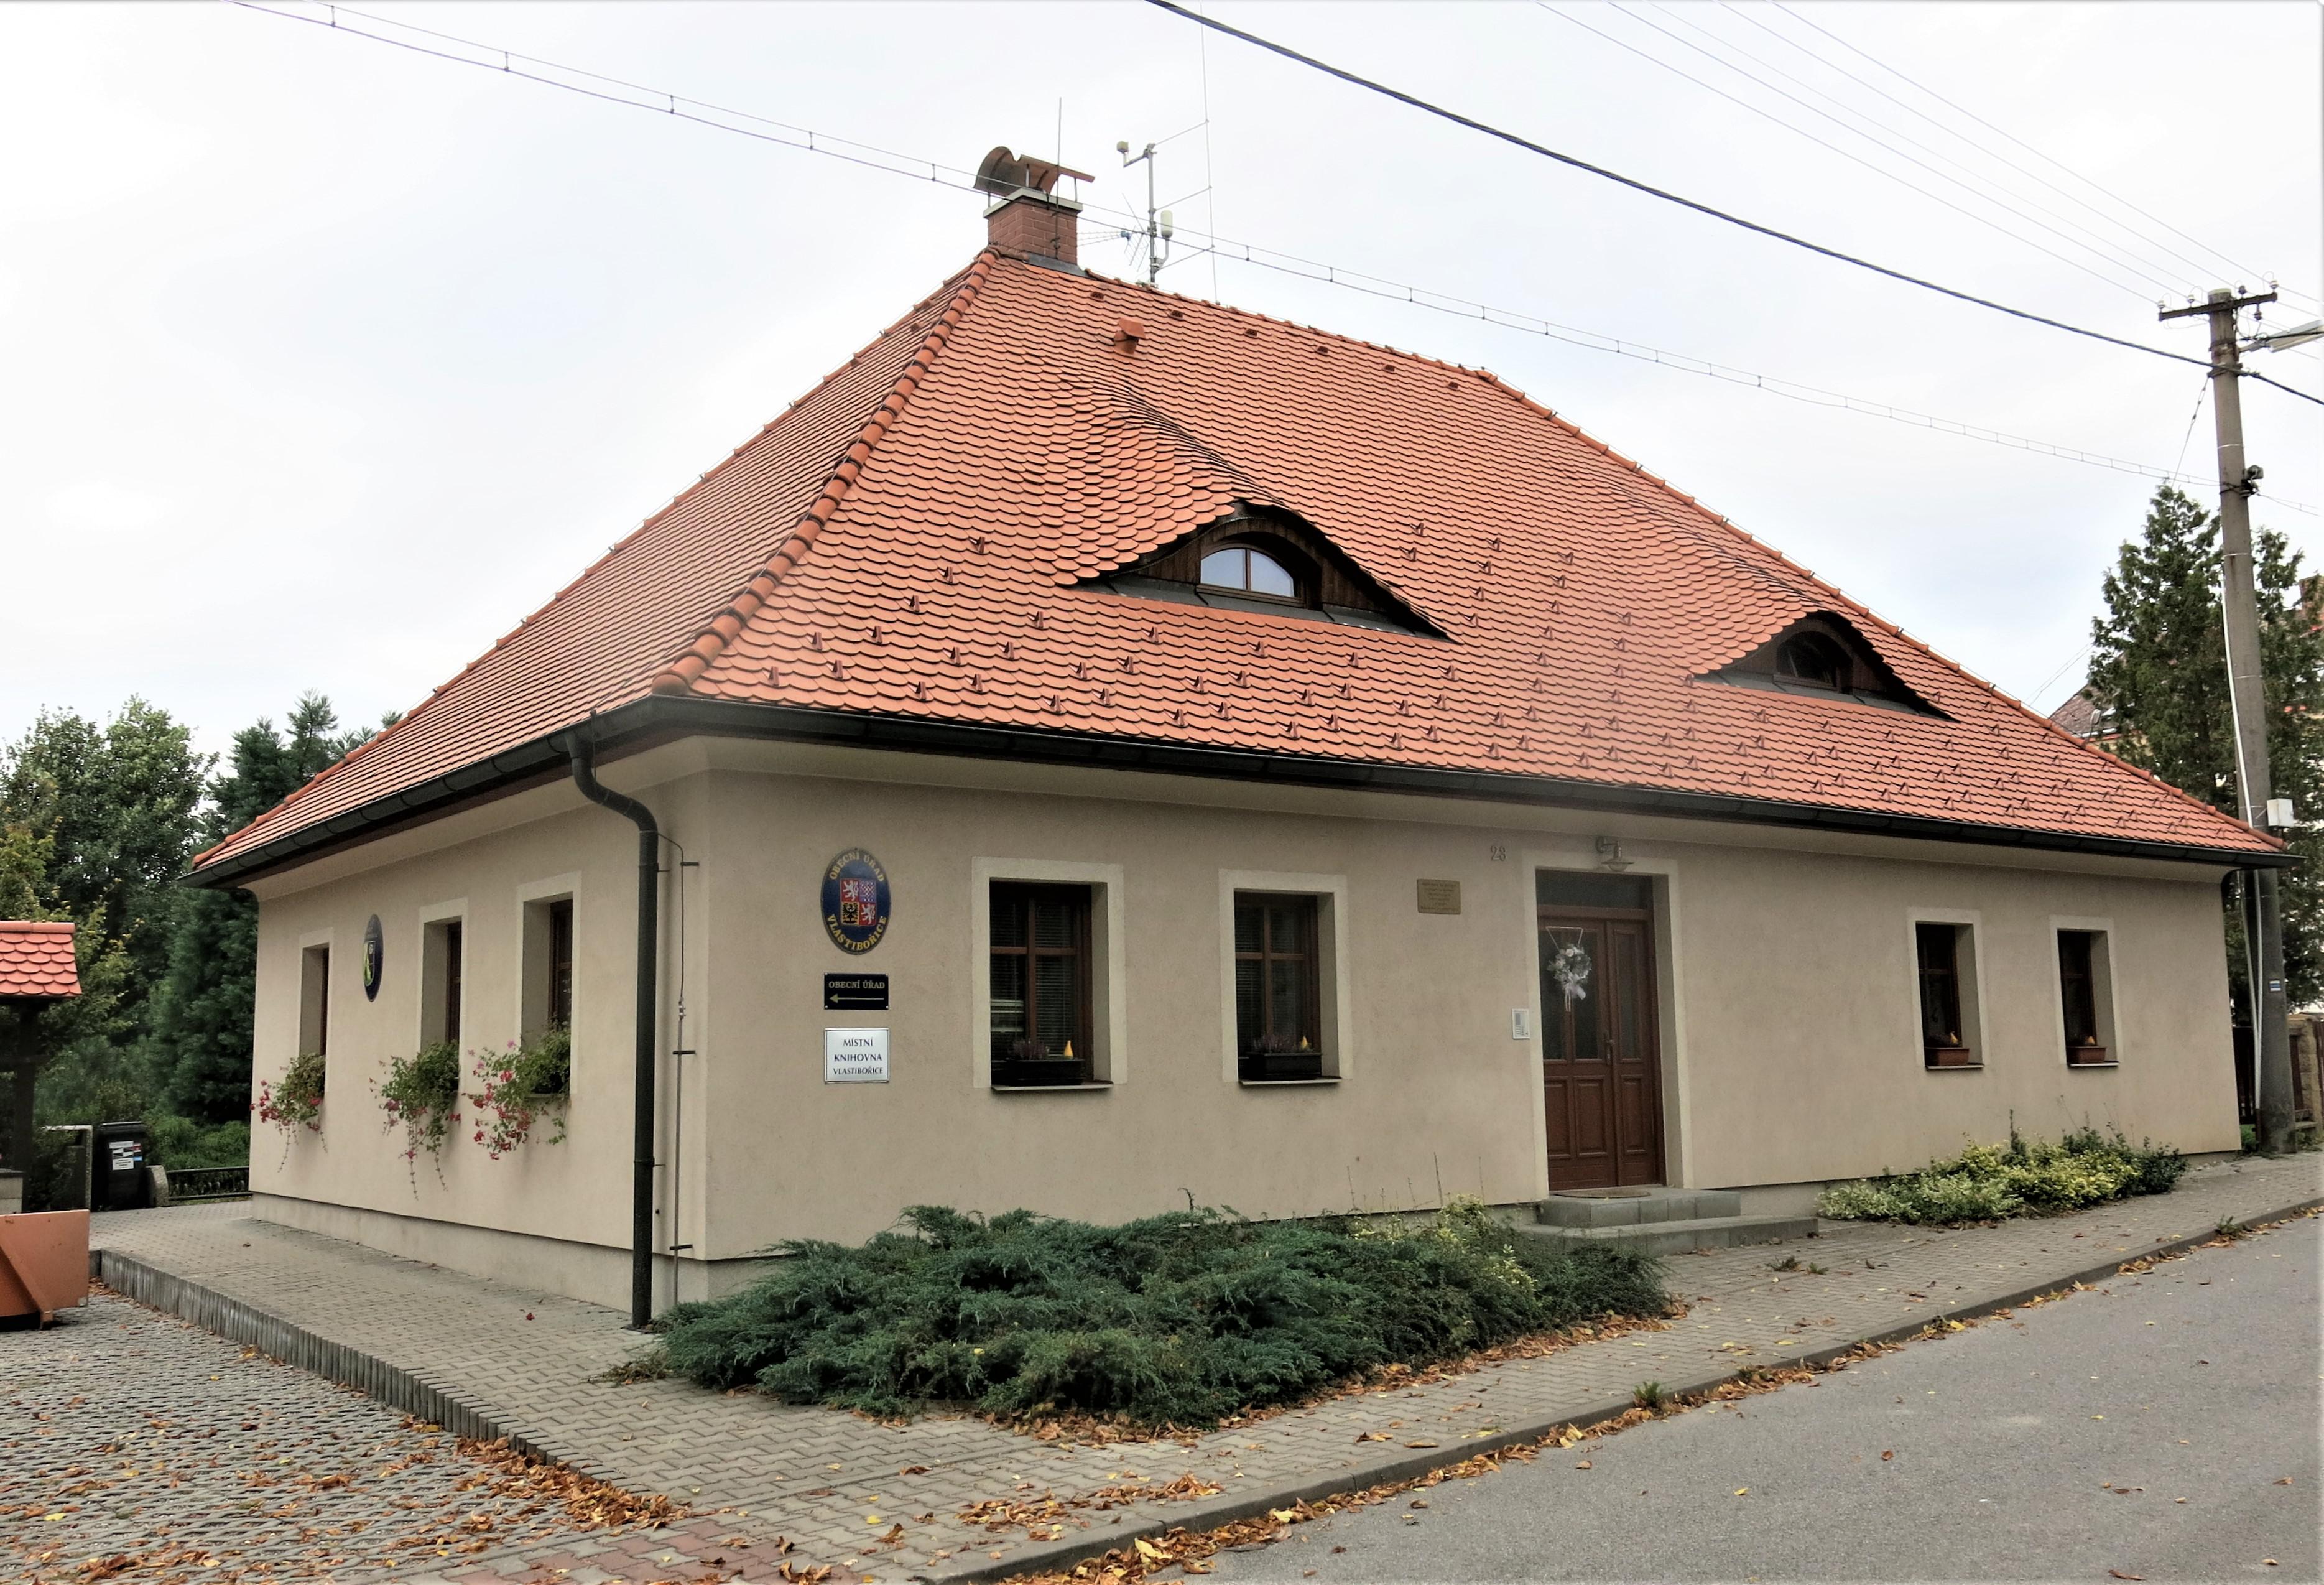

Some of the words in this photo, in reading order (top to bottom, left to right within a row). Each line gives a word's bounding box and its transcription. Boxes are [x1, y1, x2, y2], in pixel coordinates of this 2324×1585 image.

[828, 914, 887, 951] VLASTIBOŘICE
[828, 980, 860, 988] OBECNÍ
[863, 980, 885, 989] ÚŘAD
[843, 1038, 873, 1047] MÍSTNÍ
[834, 1053, 883, 1062] KNIHOVNA
[833, 1067, 883, 1075] VLASTIBOŘICE
